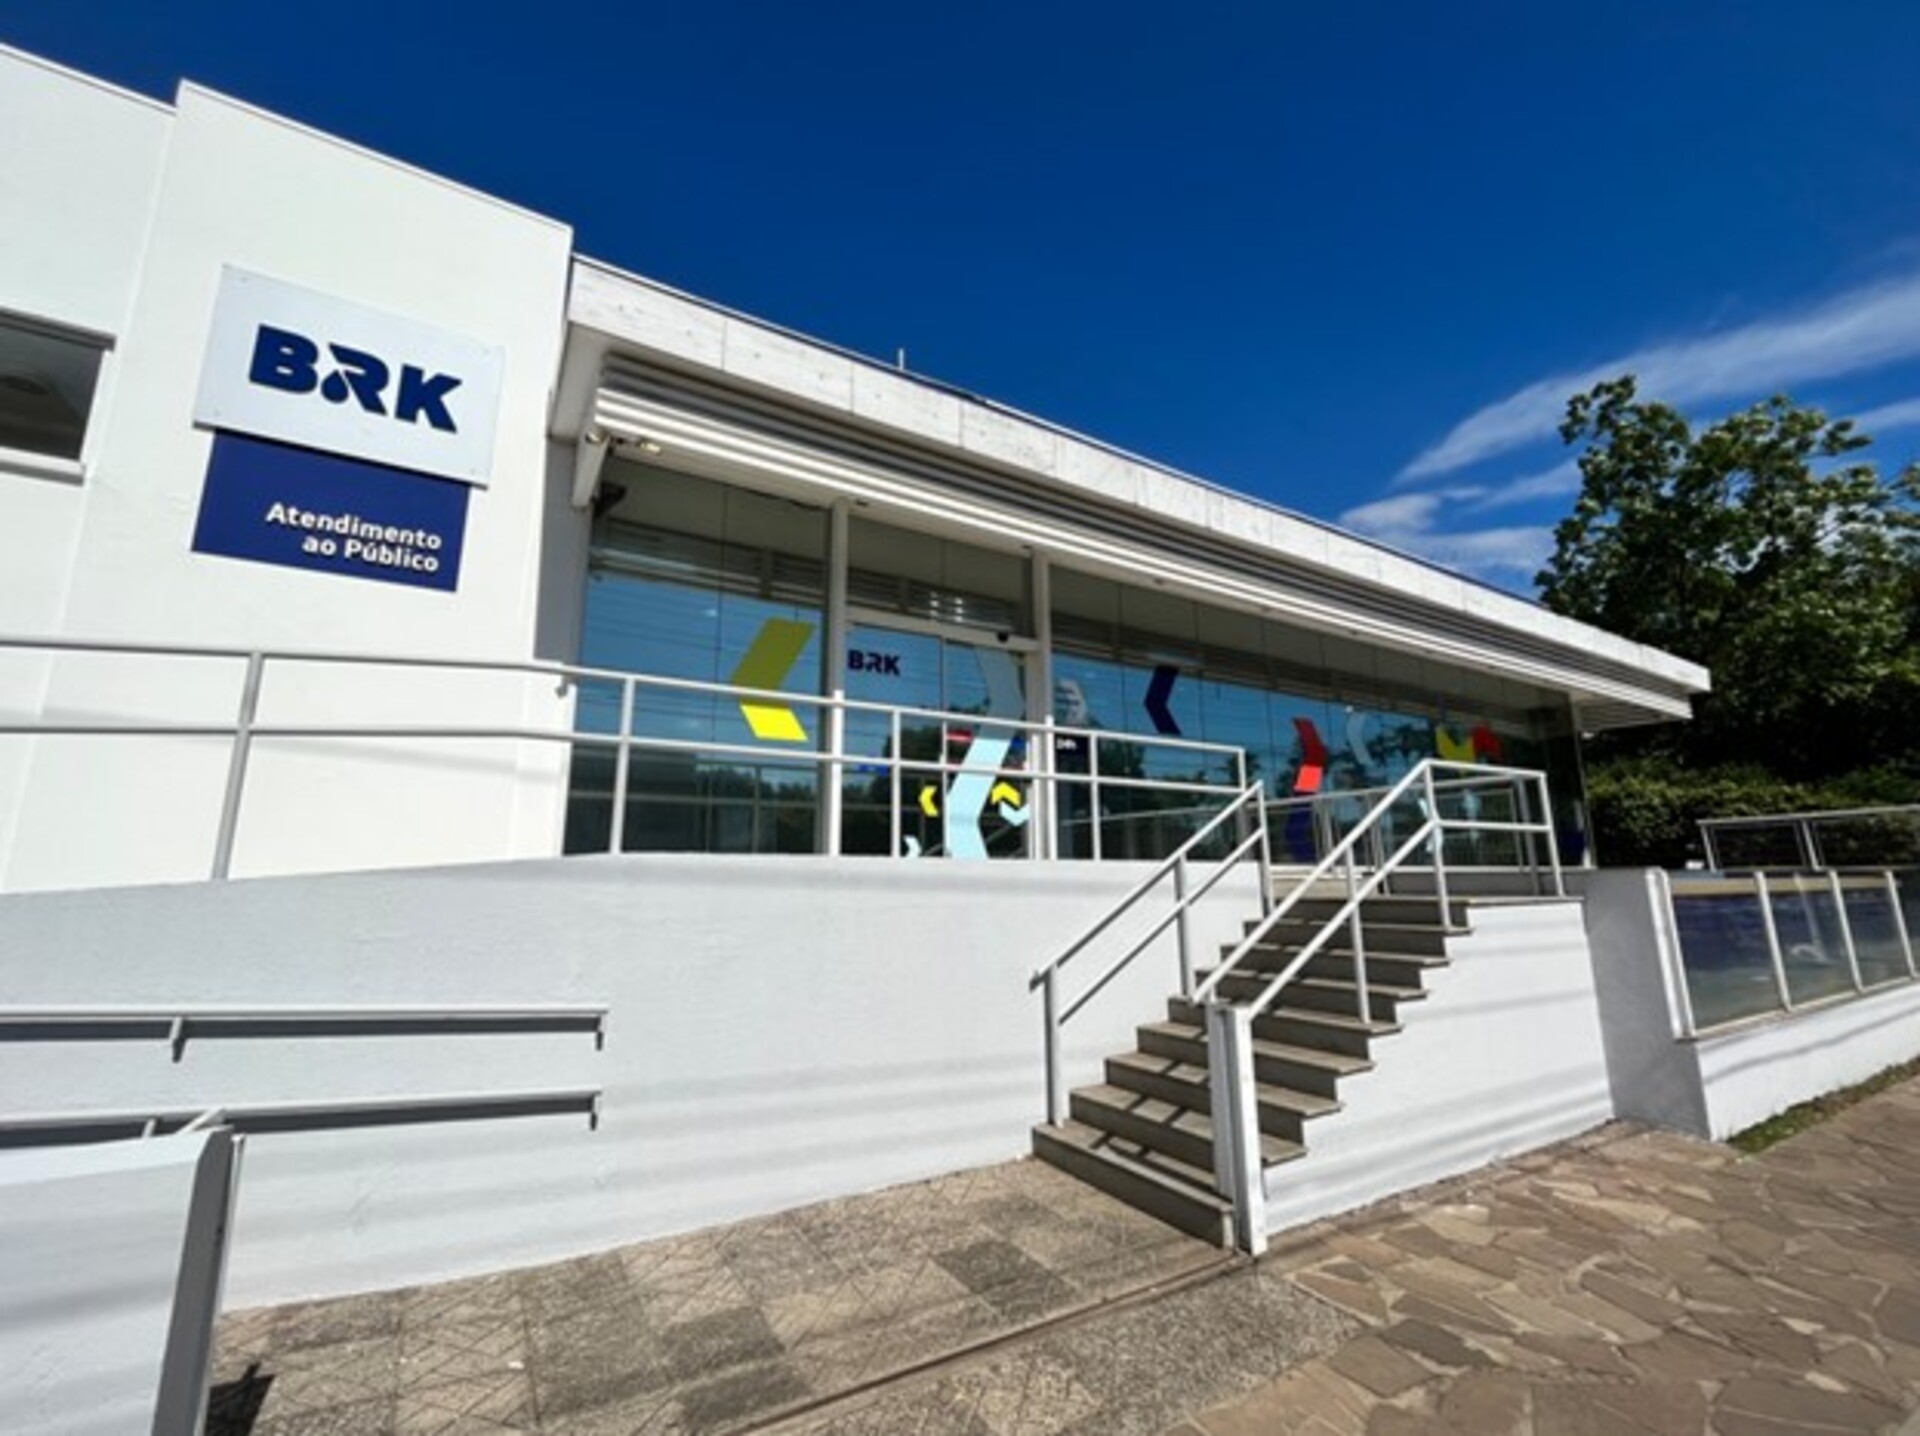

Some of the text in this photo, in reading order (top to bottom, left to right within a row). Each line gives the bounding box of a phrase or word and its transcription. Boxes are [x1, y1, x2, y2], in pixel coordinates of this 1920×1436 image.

[248, 323, 463, 434] BRK
[265, 502, 442, 549] Atendimento
[302, 536, 439, 572] ao Público
[848, 649, 901, 677] BRK
